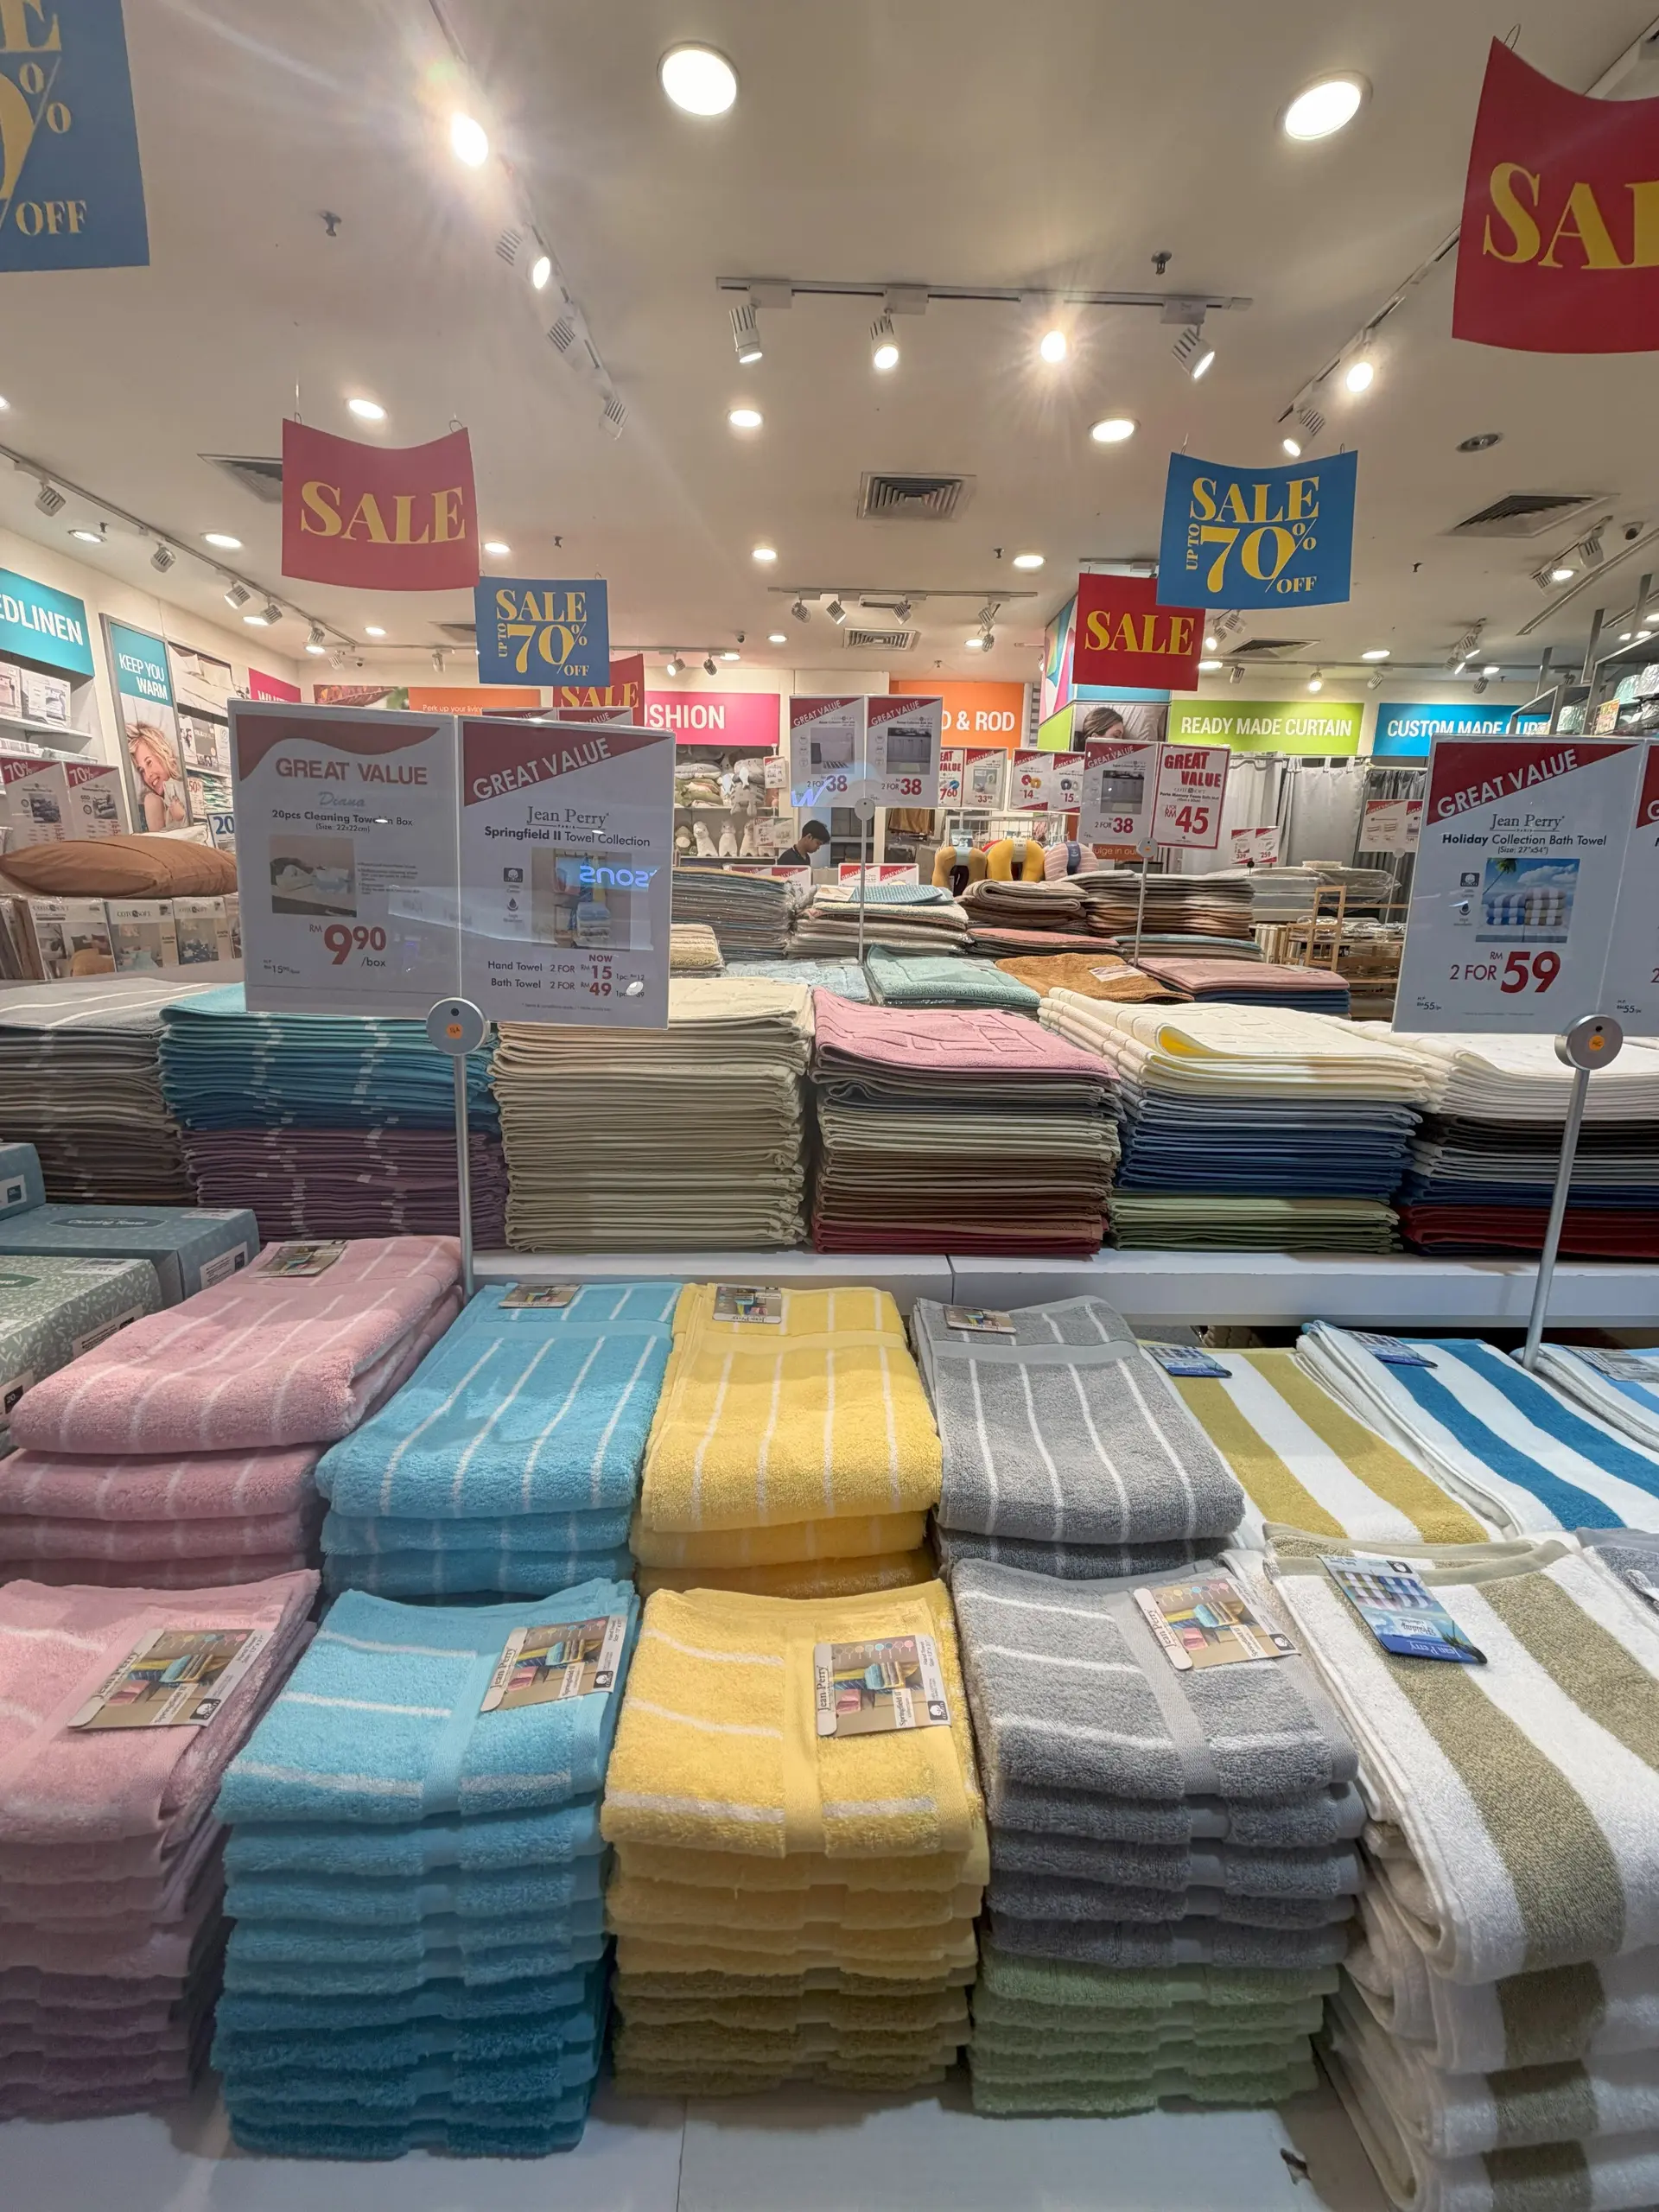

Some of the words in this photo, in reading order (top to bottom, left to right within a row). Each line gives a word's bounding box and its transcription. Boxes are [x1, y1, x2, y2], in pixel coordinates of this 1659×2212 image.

[16, 200, 86, 236] OFF
[1190, 476, 1319, 523] SALE
[300, 481, 466, 544] SALE
[1186, 524, 1199, 547] TO
[1185, 550, 1198, 571] UP
[1199, 518, 1318, 594] 70%
[1276, 575, 1318, 594] OFF
[495, 588, 588, 622] SALE
[497, 623, 507, 640] TO
[1084, 610, 1195, 656] SALE
[498, 642, 508, 658] UP
[506, 622, 588, 675] 70%
[118, 653, 144, 675] KEEP
[144, 661, 165, 682] YOU
[563, 664, 589, 677] OFF
[136, 677, 168, 701] WARM
[560, 681, 639, 708] SALE
[645, 703, 726, 729] SHION
[793, 711, 817, 727] GREAT
[817, 700, 841, 717] VALUE
[871, 711, 895, 727] GREAT
[895, 700, 920, 716] VALUE
[957, 710, 970, 731] &
[976, 711, 1015, 732] ROD
[1180, 716, 1233, 734] READY
[1236, 718, 1281, 735] MADE
[1285, 719, 1352, 737] CURTAIN
[1387, 720, 1454, 737] CUSTOM
[1458, 721, 1503, 734] MADE
[939, 762, 961, 772] VALUE
[968, 756, 982, 765] GREAT
[1088, 754, 1110, 768] GREAT
[1110, 745, 1135, 760] VALUE
[1165, 752, 1210, 770] GREAT
[4, 761, 33, 781] 70%
[69, 767, 94, 785] 70%
[275, 758, 350, 781] GREAT
[358, 763, 429, 785] VALUE
[473, 760, 540, 799] GREAT
[542, 737, 611, 776] VALUE
[826, 775, 848, 792] 38
[900, 779, 922, 795] 38
[1181, 771, 1222, 787] VALUE
[1437, 776, 1506, 818] GREAT
[1508, 749, 1578, 791] VALUE
[318, 791, 367, 808] Diana
[1023, 790, 1033, 799] 14
[1064, 793, 1074, 803] 15
[213, 816, 234, 835] 20
[272, 810, 302, 820] 20pcs
[304, 811, 350, 824] Cleaning
[353, 815, 381, 823] Towe
[397, 817, 413, 826] Box
[527, 805, 560, 823] Jean
[564, 808, 607, 828] Perry
[1113, 817, 1134, 834] 38
[1175, 806, 1210, 835] 45
[1490, 814, 1520, 830] Jean
[1524, 814, 1562, 830] Perry
[484, 825, 550, 841] Springfield
[553, 831, 561, 840] II
[565, 831, 594, 843] Towel
[598, 834, 651, 847] Collection
[1442, 834, 1488, 846] Holiday
[1492, 834, 1546, 845] Collection
[1549, 835, 1573, 845] Bath
[1577, 836, 1607, 846] Towel
[309, 924, 322, 932] RM
[361, 957, 386, 967] /box
[589, 954, 613, 963] NOW
[1490, 951, 1503, 960] RM
[487, 961, 513, 970] Hand
[516, 962, 543, 971] Towel
[591, 965, 613, 980] 15
[1449, 965, 1459, 980] 2
[1465, 964, 1497, 981] FOR
[1500, 950, 1561, 994] 59
[491, 978, 512, 987] Bath
[515, 979, 541, 988] Towel
[557, 982, 575, 990] FOR
[589, 982, 612, 996] 49
[1144, 1607, 1162, 1631] Perry
[1158, 1630, 1176, 1651] Jean
[1439, 1647, 1461, 1658] Jean
[490, 1671, 505, 1688] Jean
[498, 1647, 516, 1669] Perry
[817, 1666, 827, 1690] Perry
[817, 1691, 830, 1712] Jean
[895, 1696, 907, 1726] Springfield
